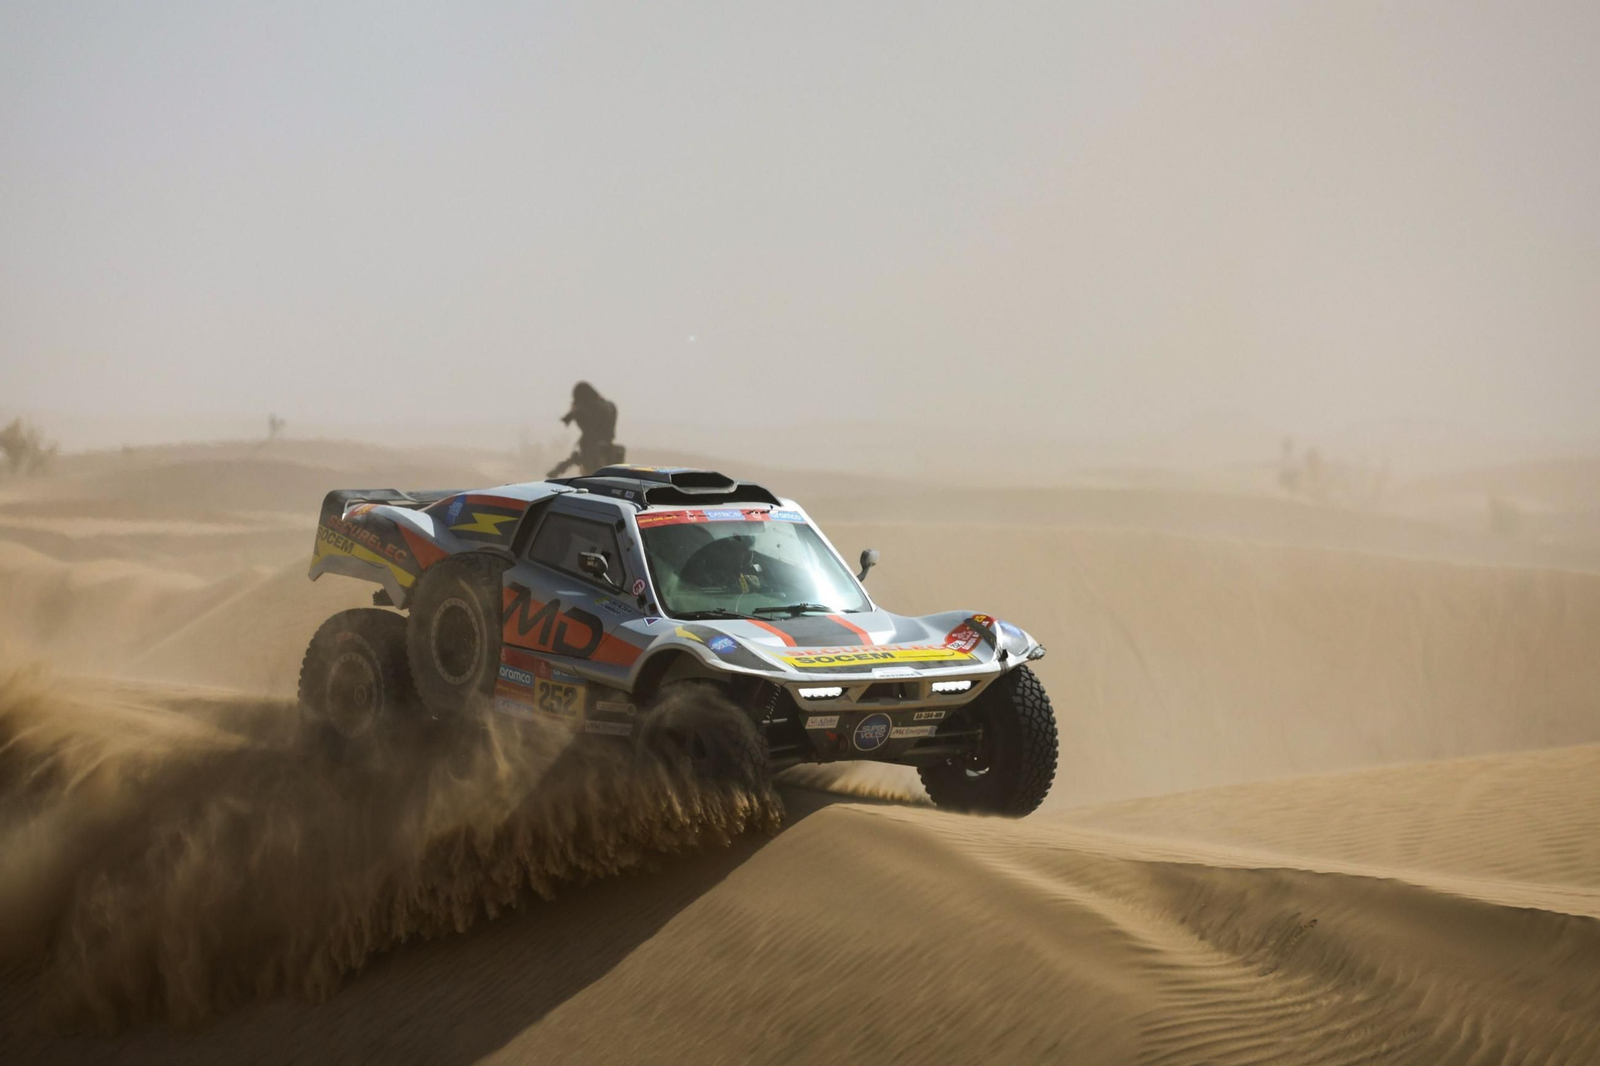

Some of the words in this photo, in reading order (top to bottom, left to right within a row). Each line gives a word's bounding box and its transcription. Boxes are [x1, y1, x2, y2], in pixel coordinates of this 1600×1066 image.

[317, 526, 355, 554] SOCEM
[795, 652, 896, 664] SOCEM
[500, 666, 531, 684] aramco
[538, 681, 578, 717] 252
[860, 731, 885, 739] VOLTS
[861, 724, 887, 733] SUPER
